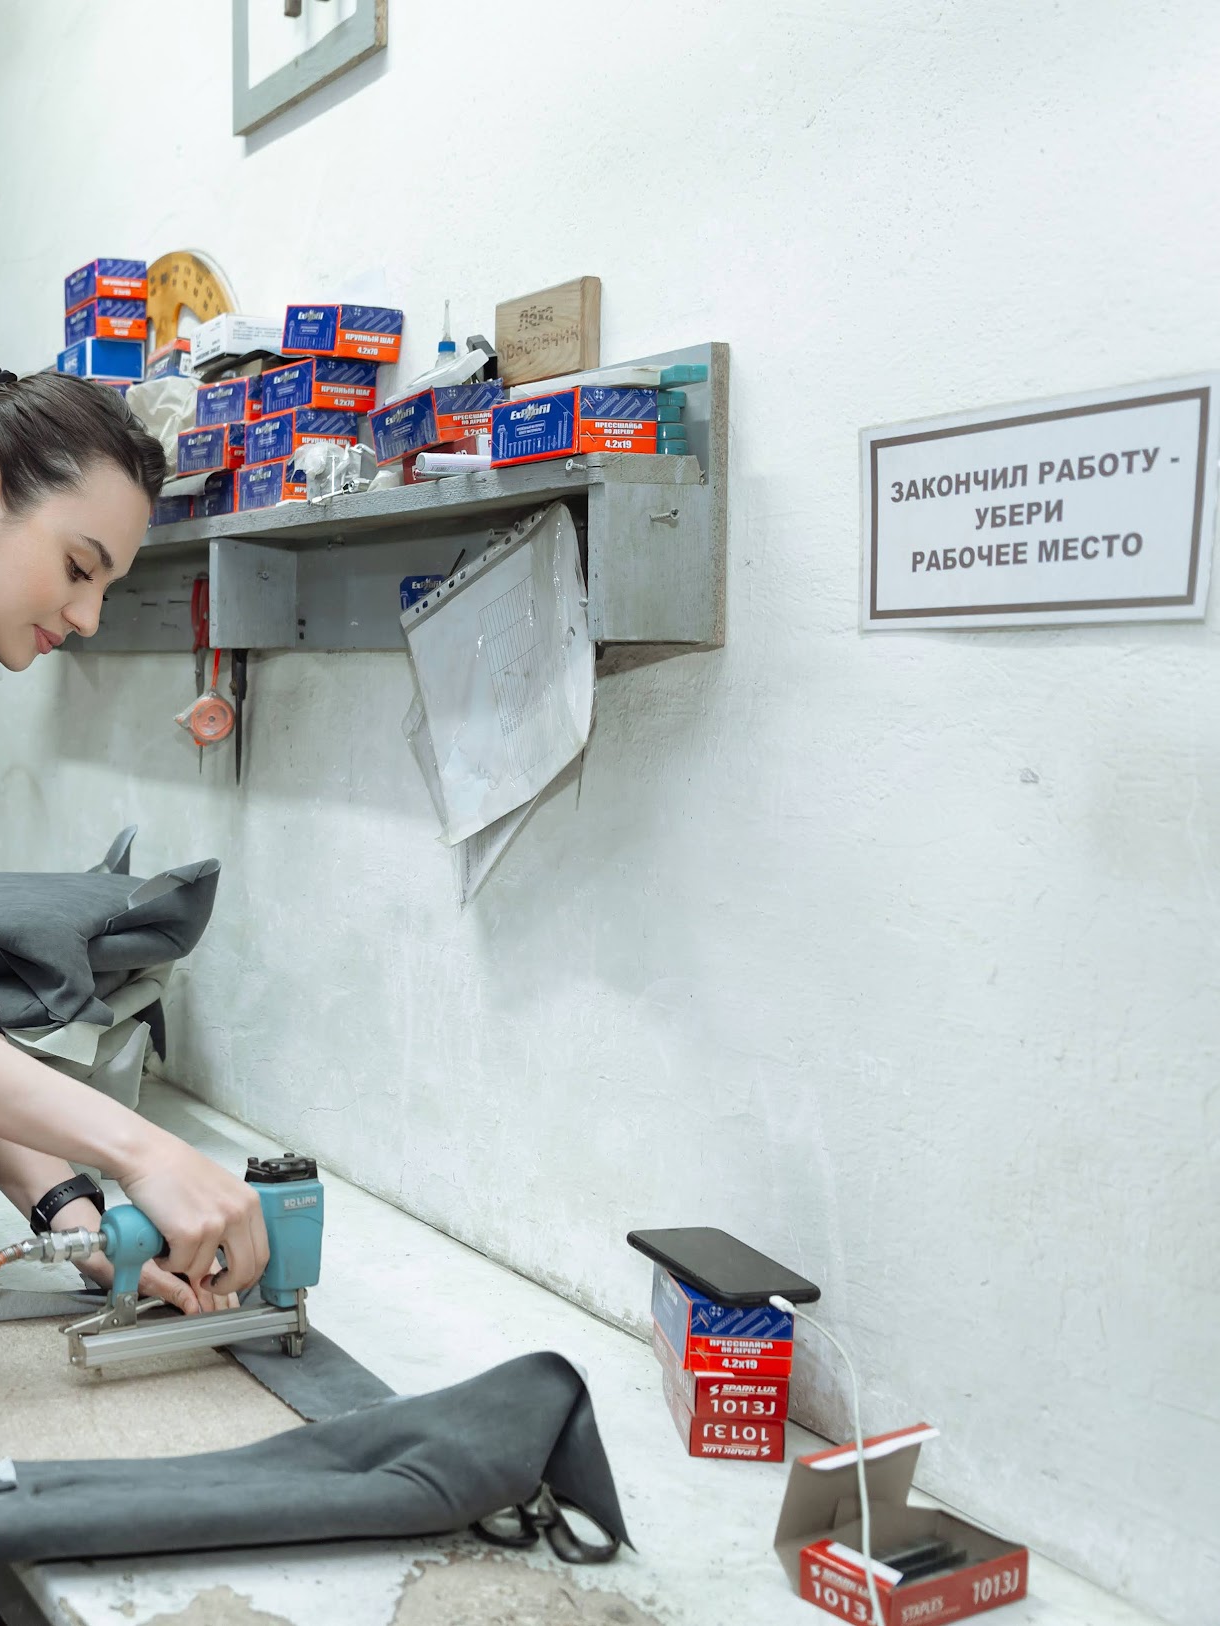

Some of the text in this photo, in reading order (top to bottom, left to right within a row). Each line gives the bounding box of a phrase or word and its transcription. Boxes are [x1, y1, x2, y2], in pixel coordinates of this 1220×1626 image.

[345, 333, 395, 345] КРУПНЫЙ ШАГ
[357, 347, 378, 355] 4.2x70
[321, 385, 370, 396] КРУПНЫЙ ШАГ
[595, 421, 643, 429] ПРЕССШАЙБА
[605, 440, 632, 449] 4.2x19
[890, 464, 1028, 503] ЗАКОНЧИЛ
[1038, 447, 1160, 485] РАБОТУ
[975, 499, 1064, 530] УБЕРИ
[912, 532, 1144, 573] РАБОЧЕЕ МЕСТО
[709, 1339, 773, 1349] ПРЕССШАЙБА
[721, 1358, 758, 1370] 4.2x19
[722, 1383, 777, 1394] SPARK LUX
[710, 1400, 776, 1416] 1013J
[703, 1423, 769, 1442] 1013J
[702, 1445, 758, 1457] SPARK LUX
[971, 1568, 1020, 1605] 1013J
[901, 1595, 944, 1624] STAPLES
